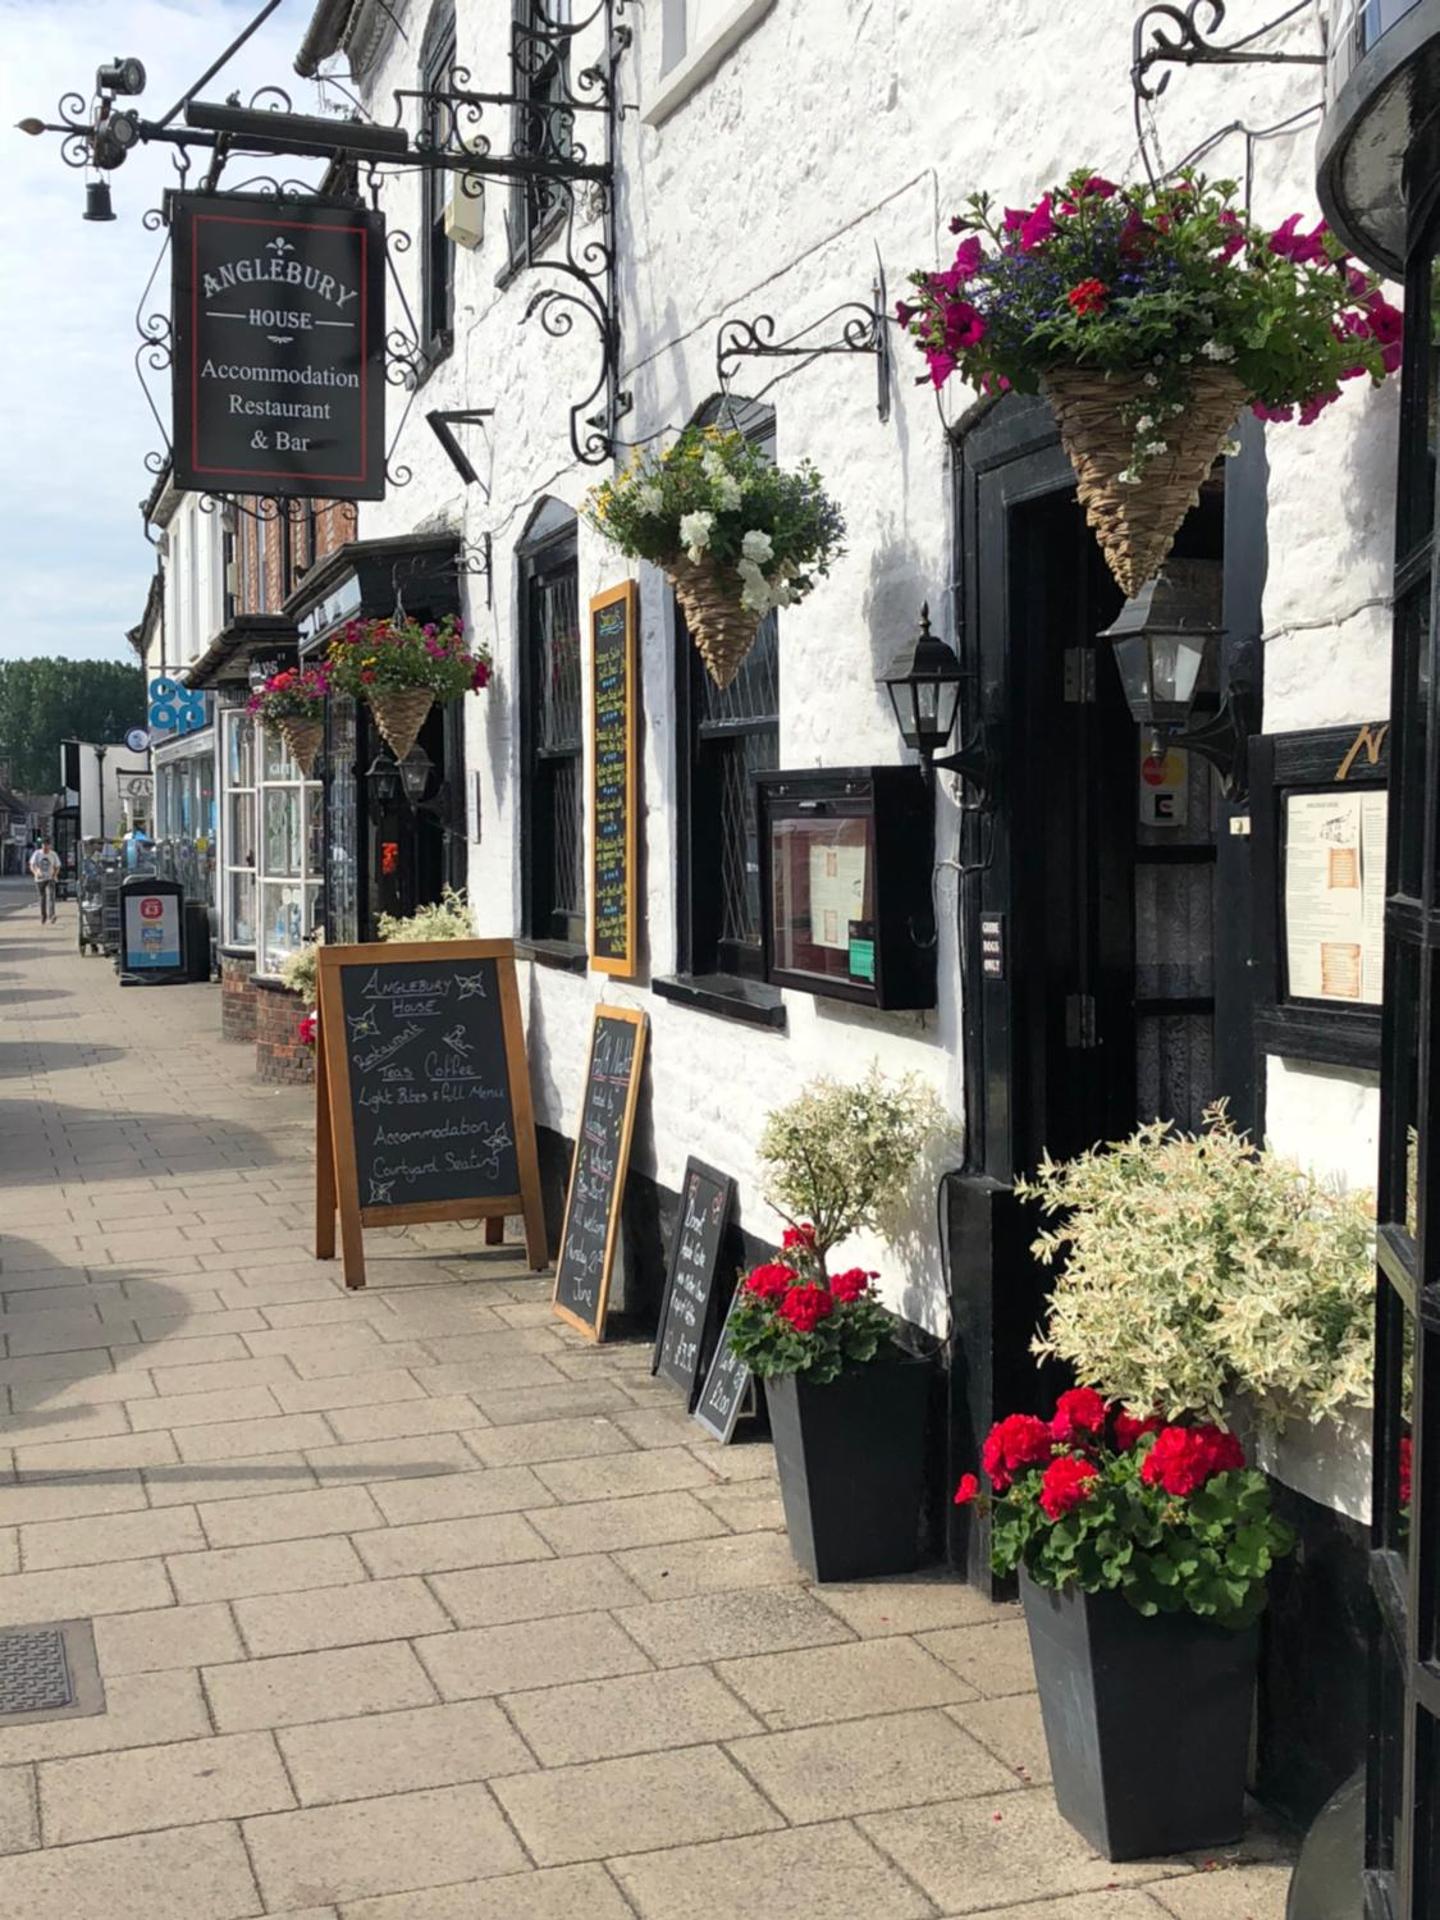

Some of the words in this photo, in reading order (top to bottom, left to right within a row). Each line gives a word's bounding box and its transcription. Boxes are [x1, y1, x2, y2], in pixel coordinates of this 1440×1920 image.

[203, 258, 358, 310] ANGLEBURY
[249, 309, 313, 329] HOUSE
[200, 359, 360, 388] Accommodation
[229, 394, 331, 420] Restaurant
[250, 430, 269, 450] &
[275, 432, 310, 452] Bar
[444, 1024, 474, 1051] Bar
[424, 1050, 477, 1077] Coffee
[373, 1117, 492, 1146] Accommodation
[444, 1148, 500, 1180] Seating
